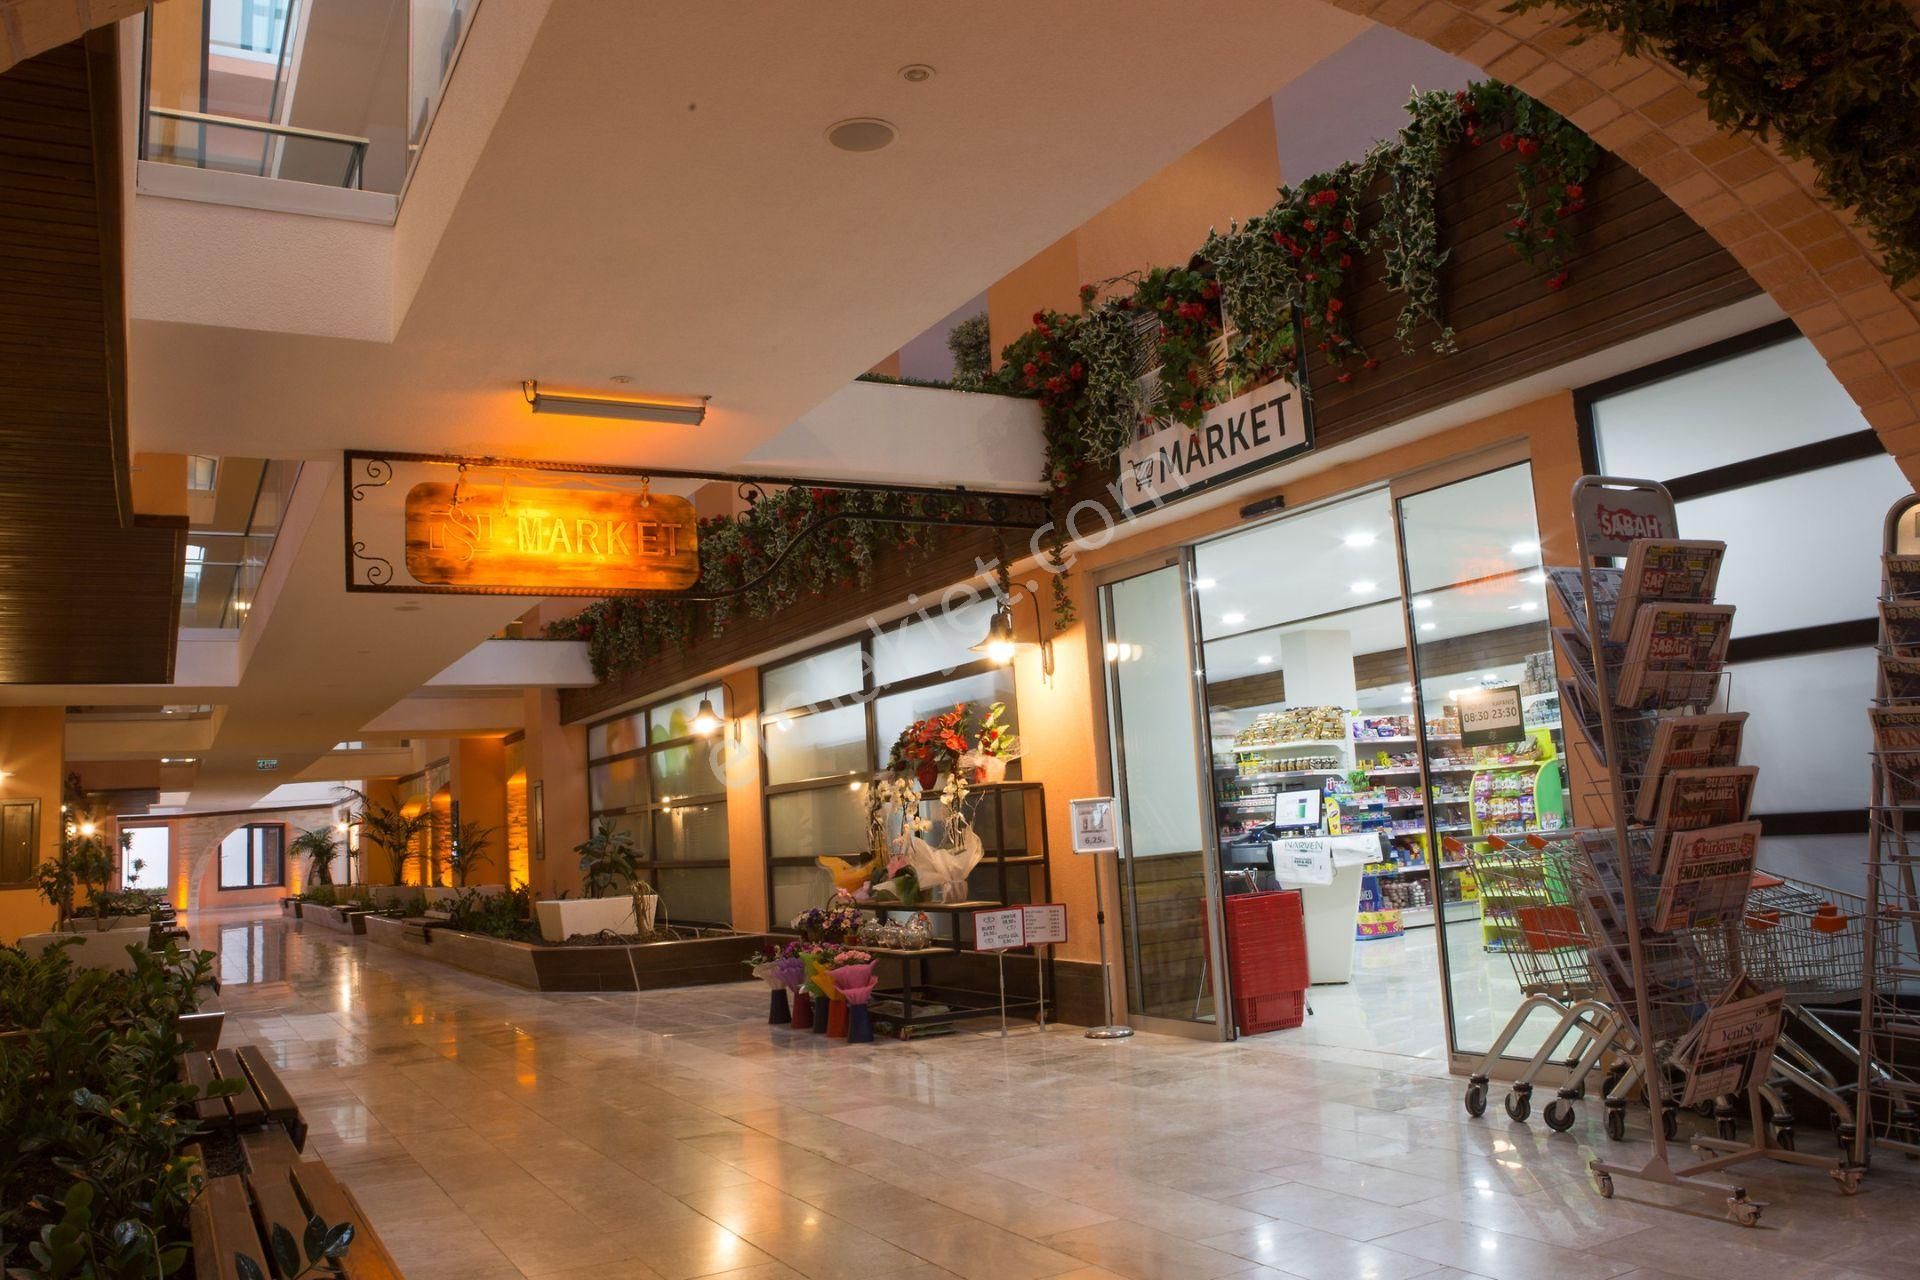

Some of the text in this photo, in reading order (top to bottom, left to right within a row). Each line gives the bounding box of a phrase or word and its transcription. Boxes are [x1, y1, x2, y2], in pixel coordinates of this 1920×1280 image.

[1159, 392, 1292, 484] MARKET
[517, 515, 682, 558] MARKET
[1601, 511, 1661, 538] SABAH
[1492, 706, 1517, 719] 23:30
